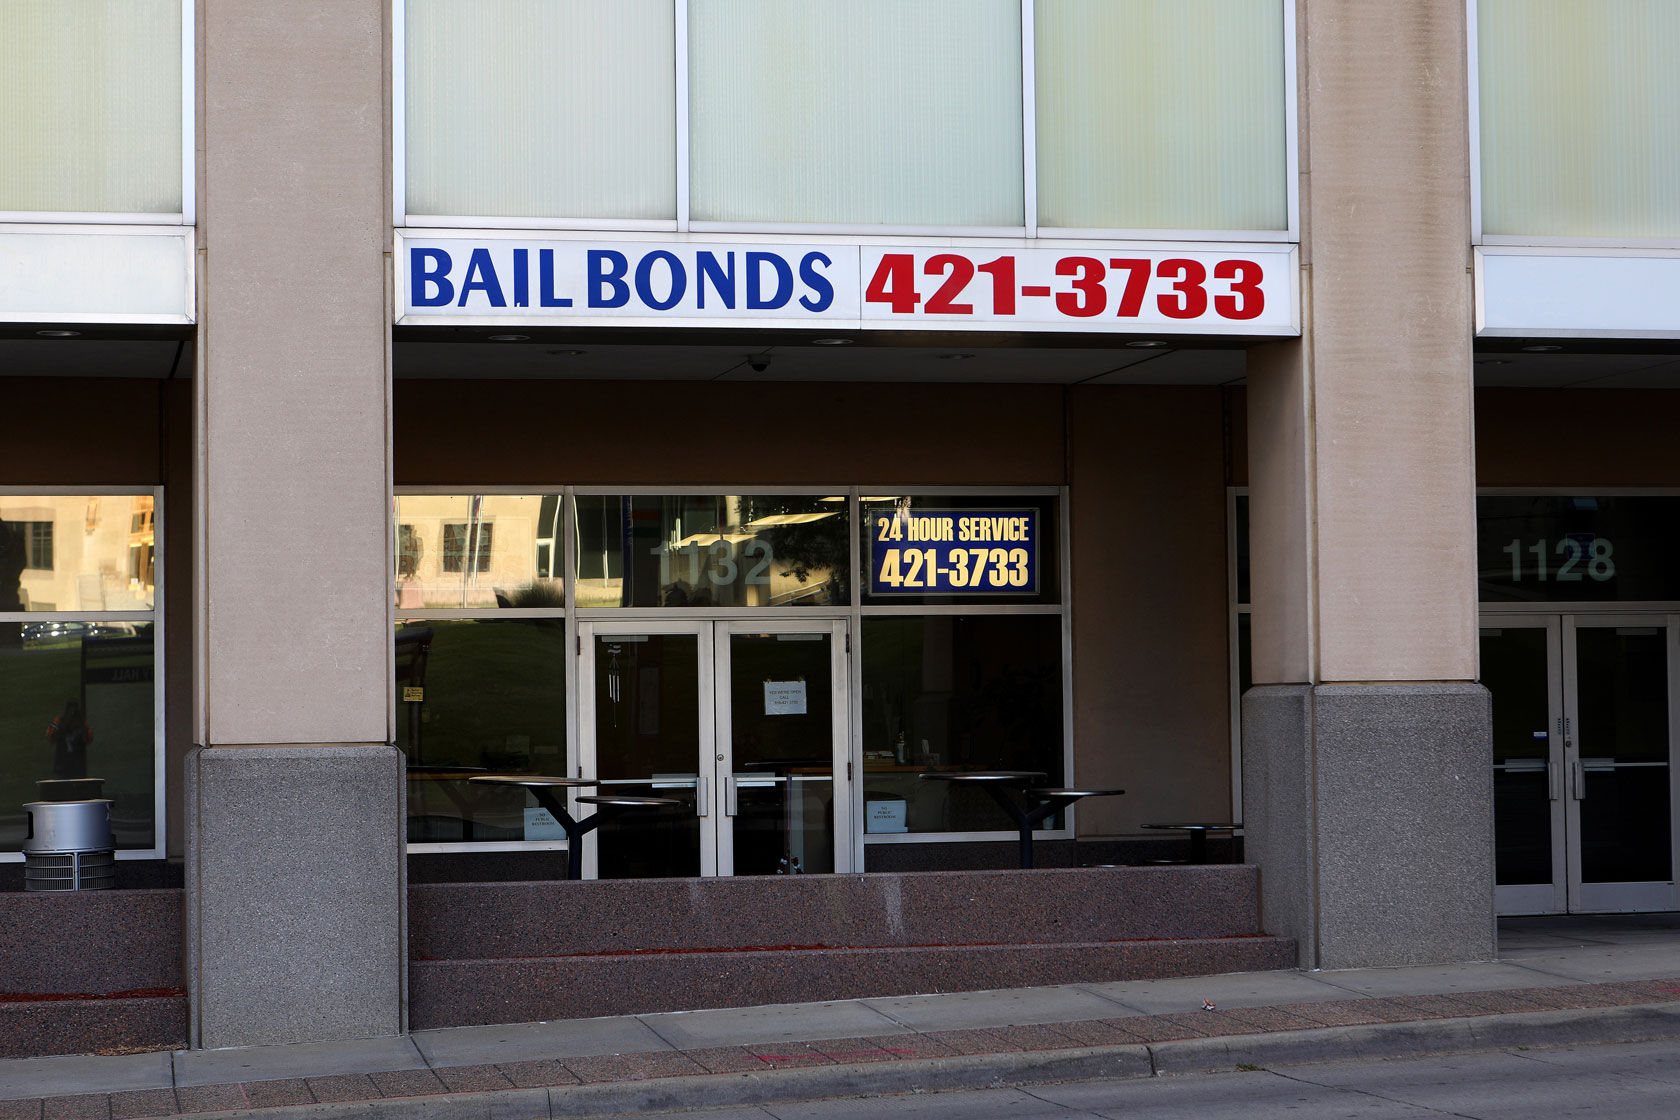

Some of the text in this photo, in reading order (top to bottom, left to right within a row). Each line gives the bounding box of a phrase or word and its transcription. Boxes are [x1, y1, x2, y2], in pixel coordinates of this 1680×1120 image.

[410, 247, 834, 313] BAIL BONDS
[865, 253, 1265, 320] 421-3733
[877, 517, 1029, 542] 24 HOUR SERVICE
[651, 539, 774, 586] 1132
[879, 547, 1029, 588] 421-3733
[1503, 537, 1616, 582] 1128
